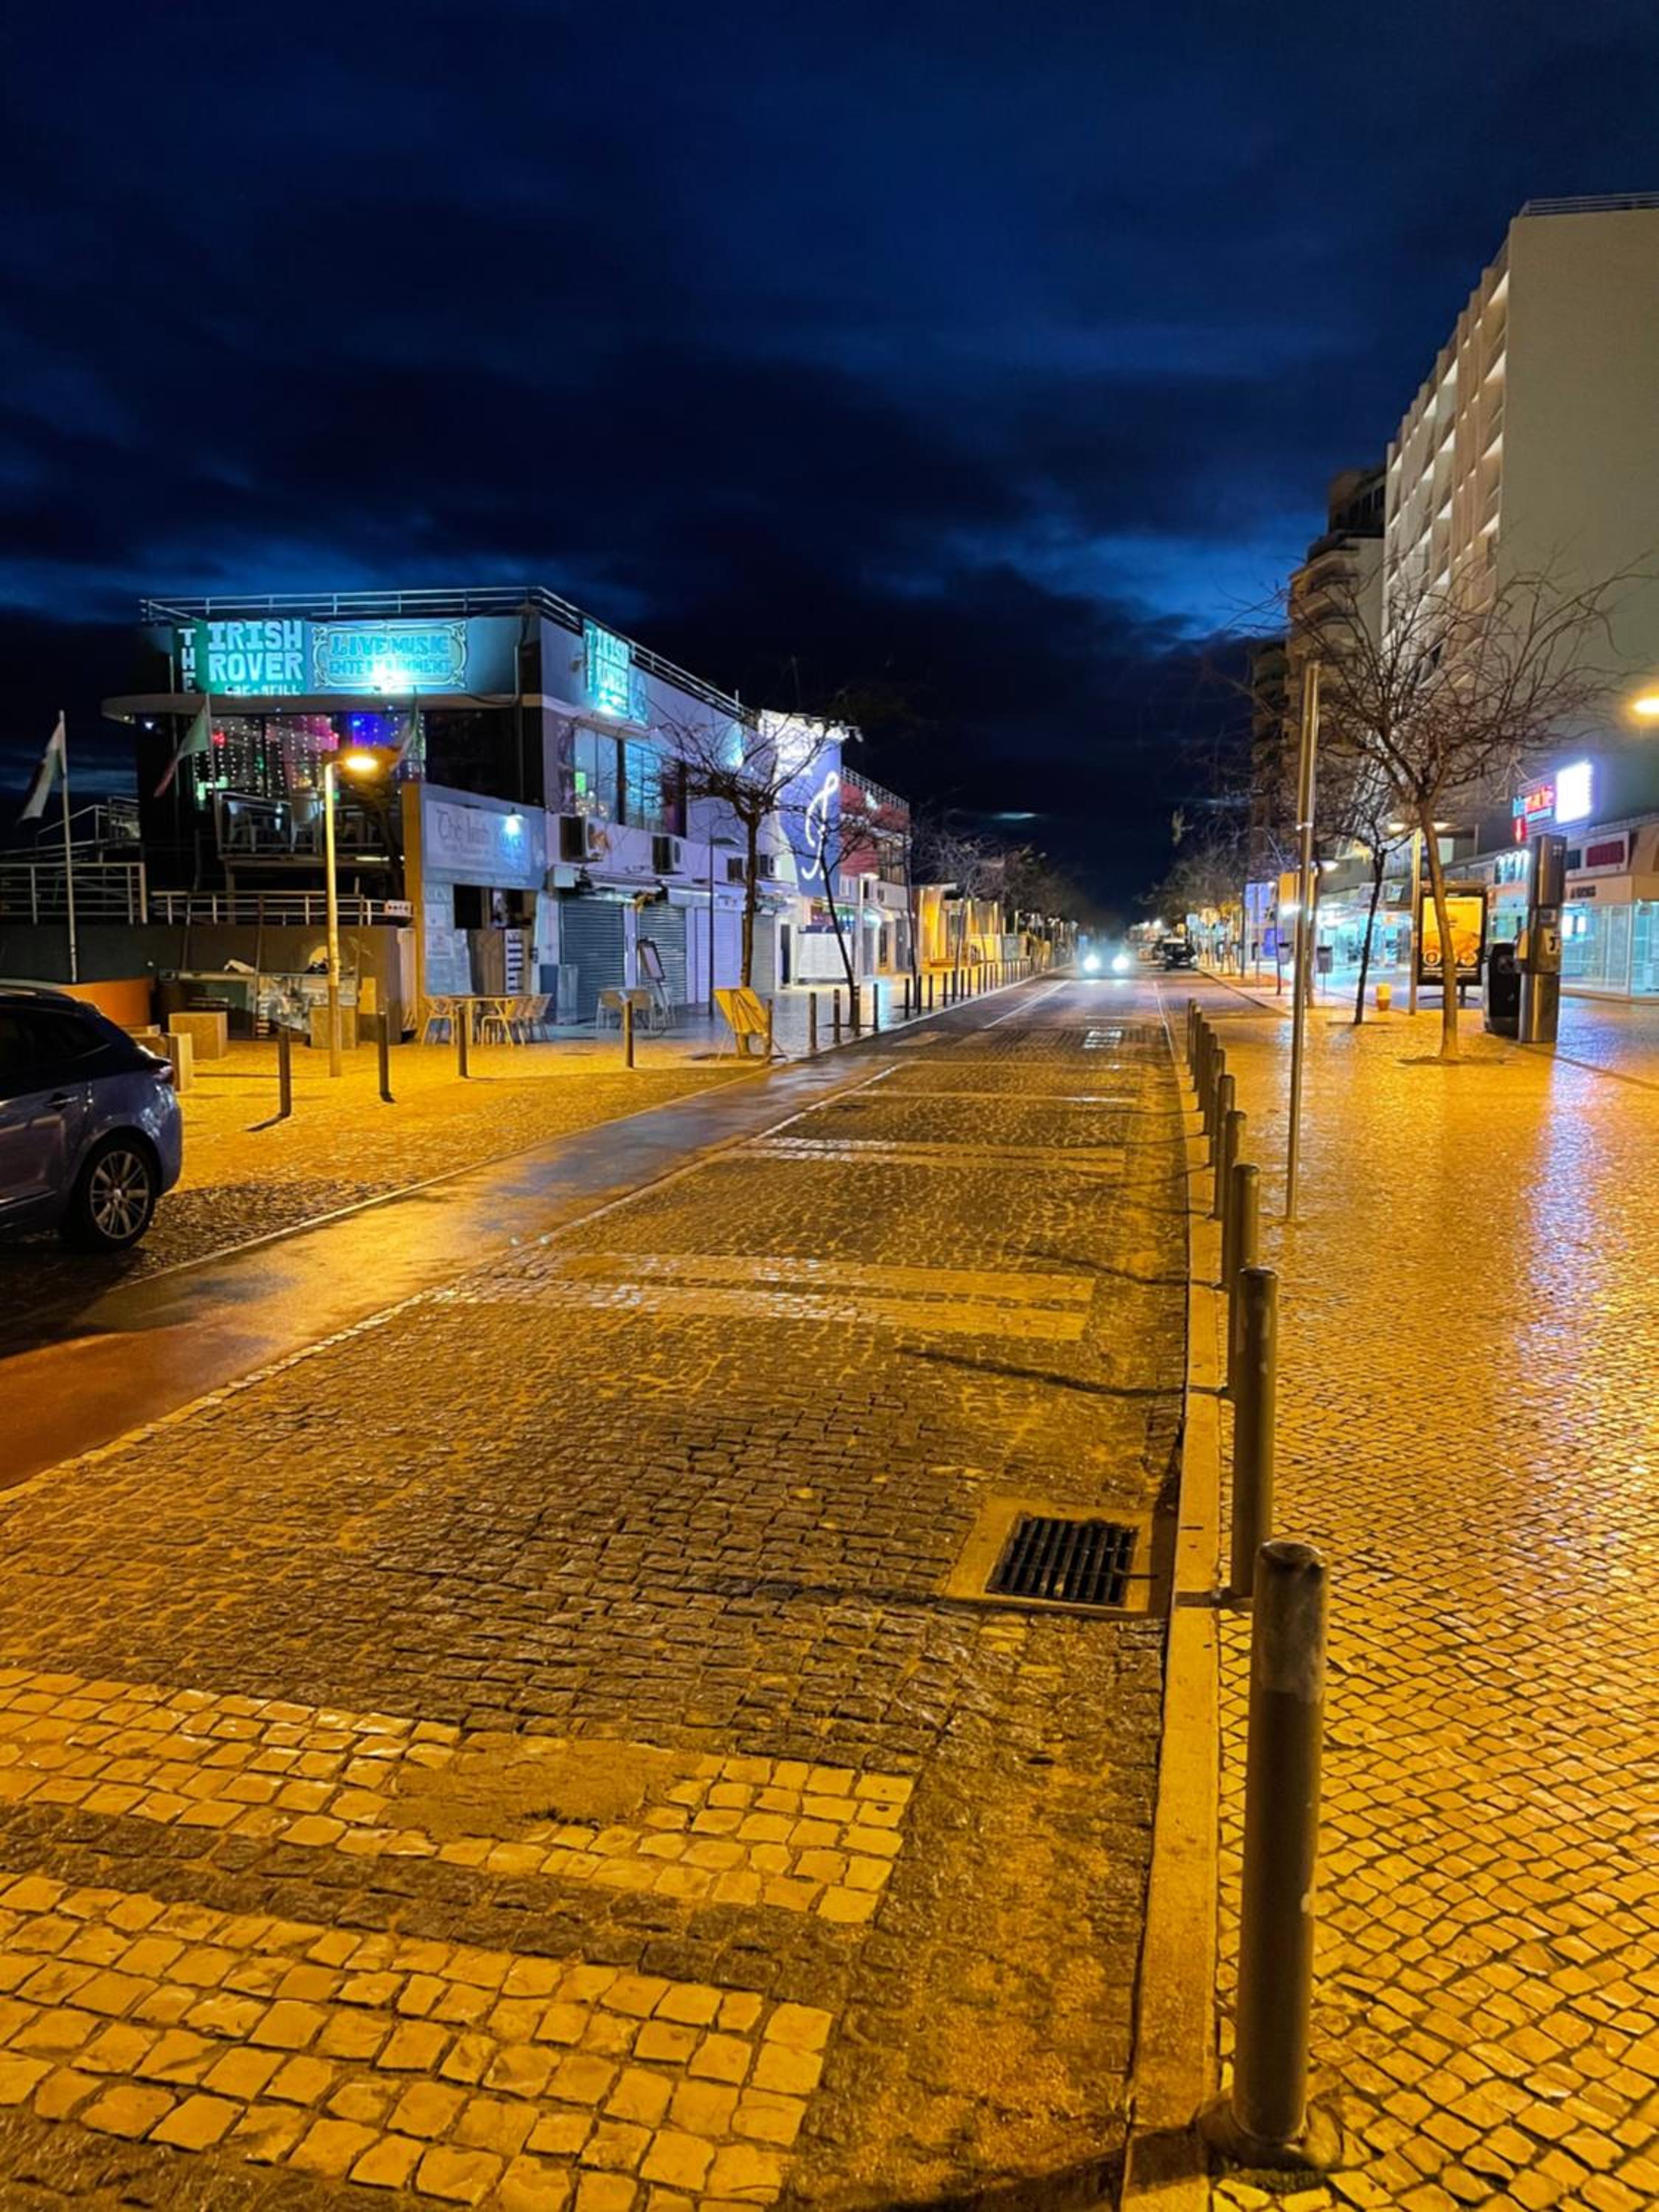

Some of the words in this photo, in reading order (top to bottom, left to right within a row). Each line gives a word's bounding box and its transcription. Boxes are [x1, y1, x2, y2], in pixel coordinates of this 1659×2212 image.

[207, 620, 302, 650] IRISH
[331, 636, 388, 655] LIVE
[391, 635, 449, 655] MUSIC
[178, 628, 196, 693] THE
[208, 652, 304, 682] ROVER
